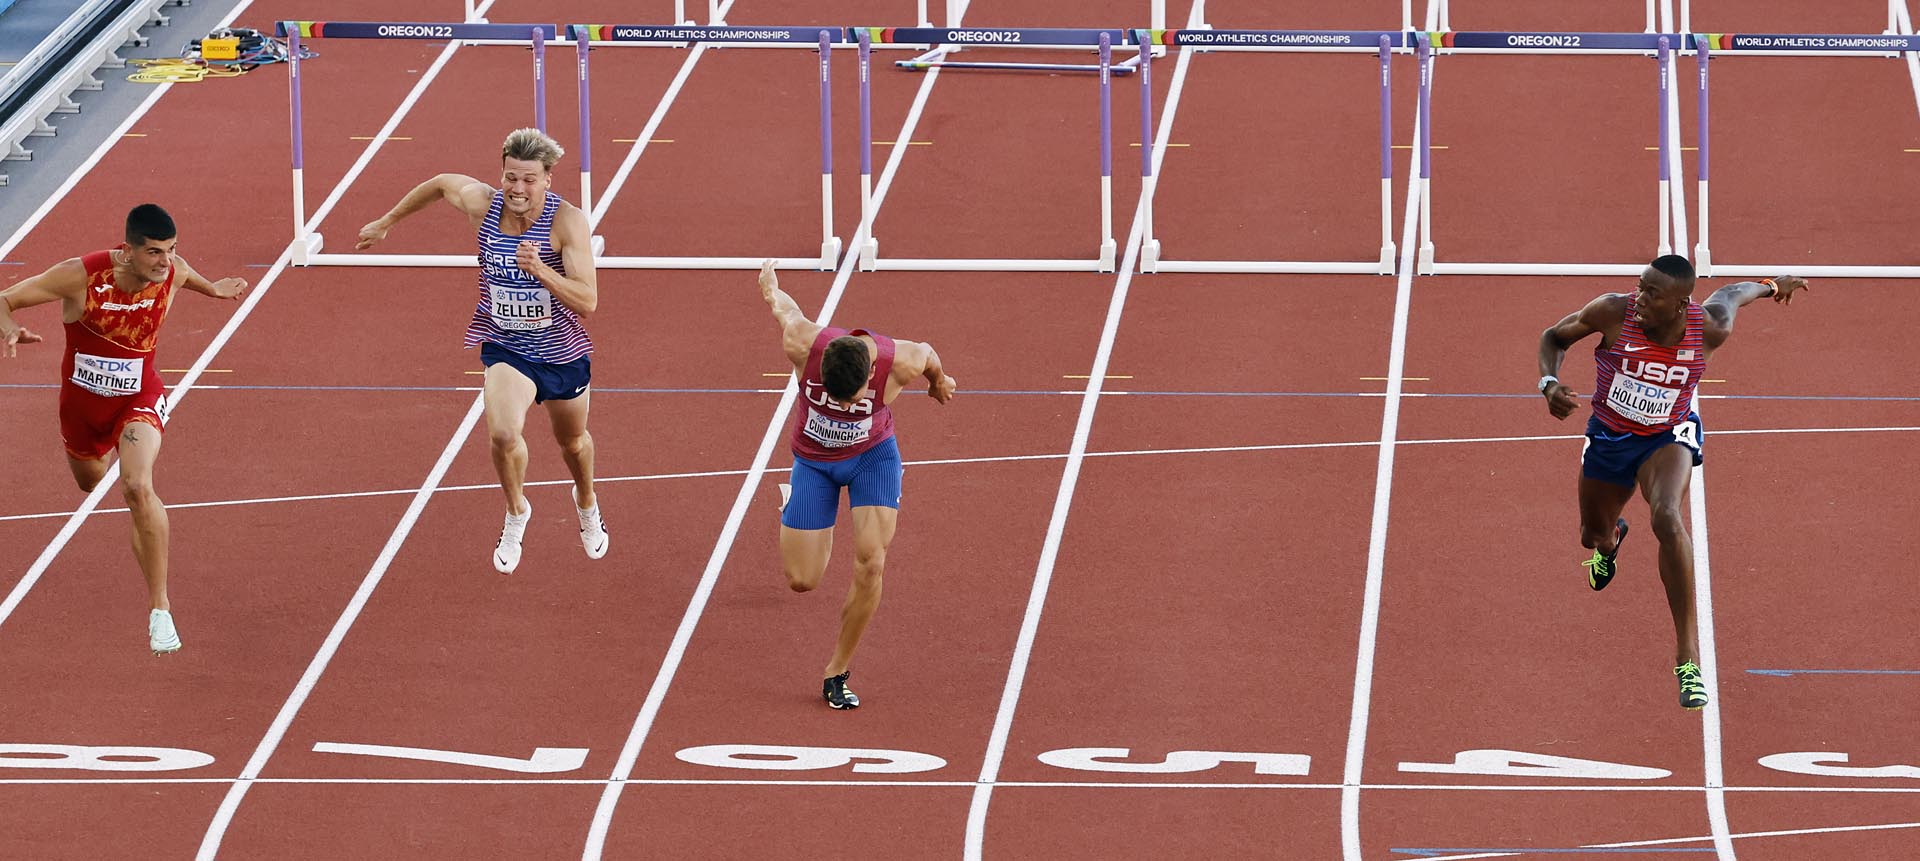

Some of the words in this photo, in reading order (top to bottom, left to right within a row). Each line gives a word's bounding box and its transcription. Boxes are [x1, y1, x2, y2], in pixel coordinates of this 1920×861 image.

[616, 28, 652, 38] WORLD
[654, 29, 706, 39] ATHLETICS
[708, 30, 790, 40] CHAMPIONSHIPS
[1178, 33, 1214, 42] WORLD
[1215, 34, 1268, 43] ATHLETICS
[1269, 34, 1351, 44] CHAMPIONSHIPS
[1736, 37, 1771, 46] WORLD
[1772, 38, 1825, 47] ATHLETICS
[1827, 38, 1909, 48] CHAMPIONSHIPS
[485, 250, 517, 267] GRE
[505, 291, 540, 302] TDK
[496, 302, 545, 318] ZELLER
[95, 359, 133, 372] TDK
[1621, 358, 1690, 385] USA
[77, 367, 138, 390] MARTÍNEZ
[1634, 382, 1671, 400] TDK
[805, 386, 873, 415] USA
[1612, 386, 1671, 414] HOLLOWAY
[825, 418, 862, 430] TDK
[1680, 426, 1690, 440] 4
[311, 742, 590, 773] 7
[674, 743, 948, 774] 6
[1037, 747, 1311, 776] 5
[1397, 748, 1673, 780] 4
